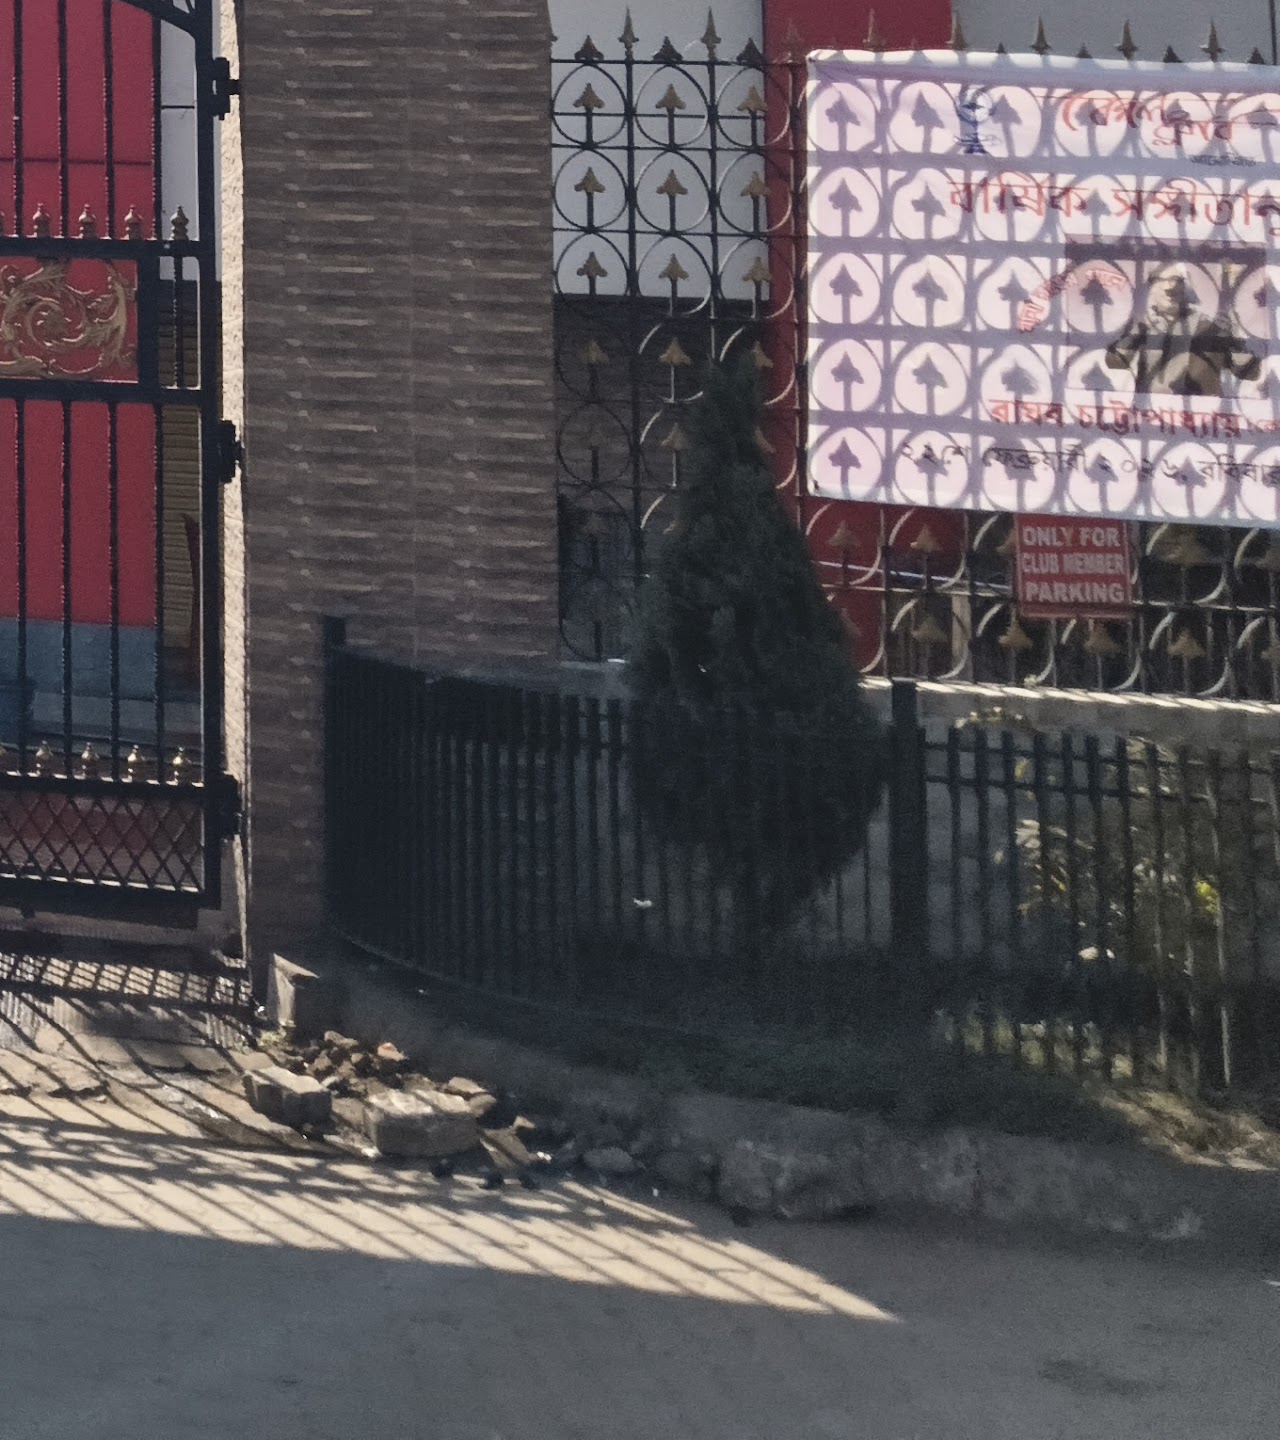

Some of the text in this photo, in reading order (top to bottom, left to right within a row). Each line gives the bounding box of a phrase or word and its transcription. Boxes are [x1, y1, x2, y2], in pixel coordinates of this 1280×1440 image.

[1022, 525, 1121, 548] ONLY FOR
[1022, 552, 1125, 575] CLUB MEMBER
[1024, 581, 1125, 604] PARKING
